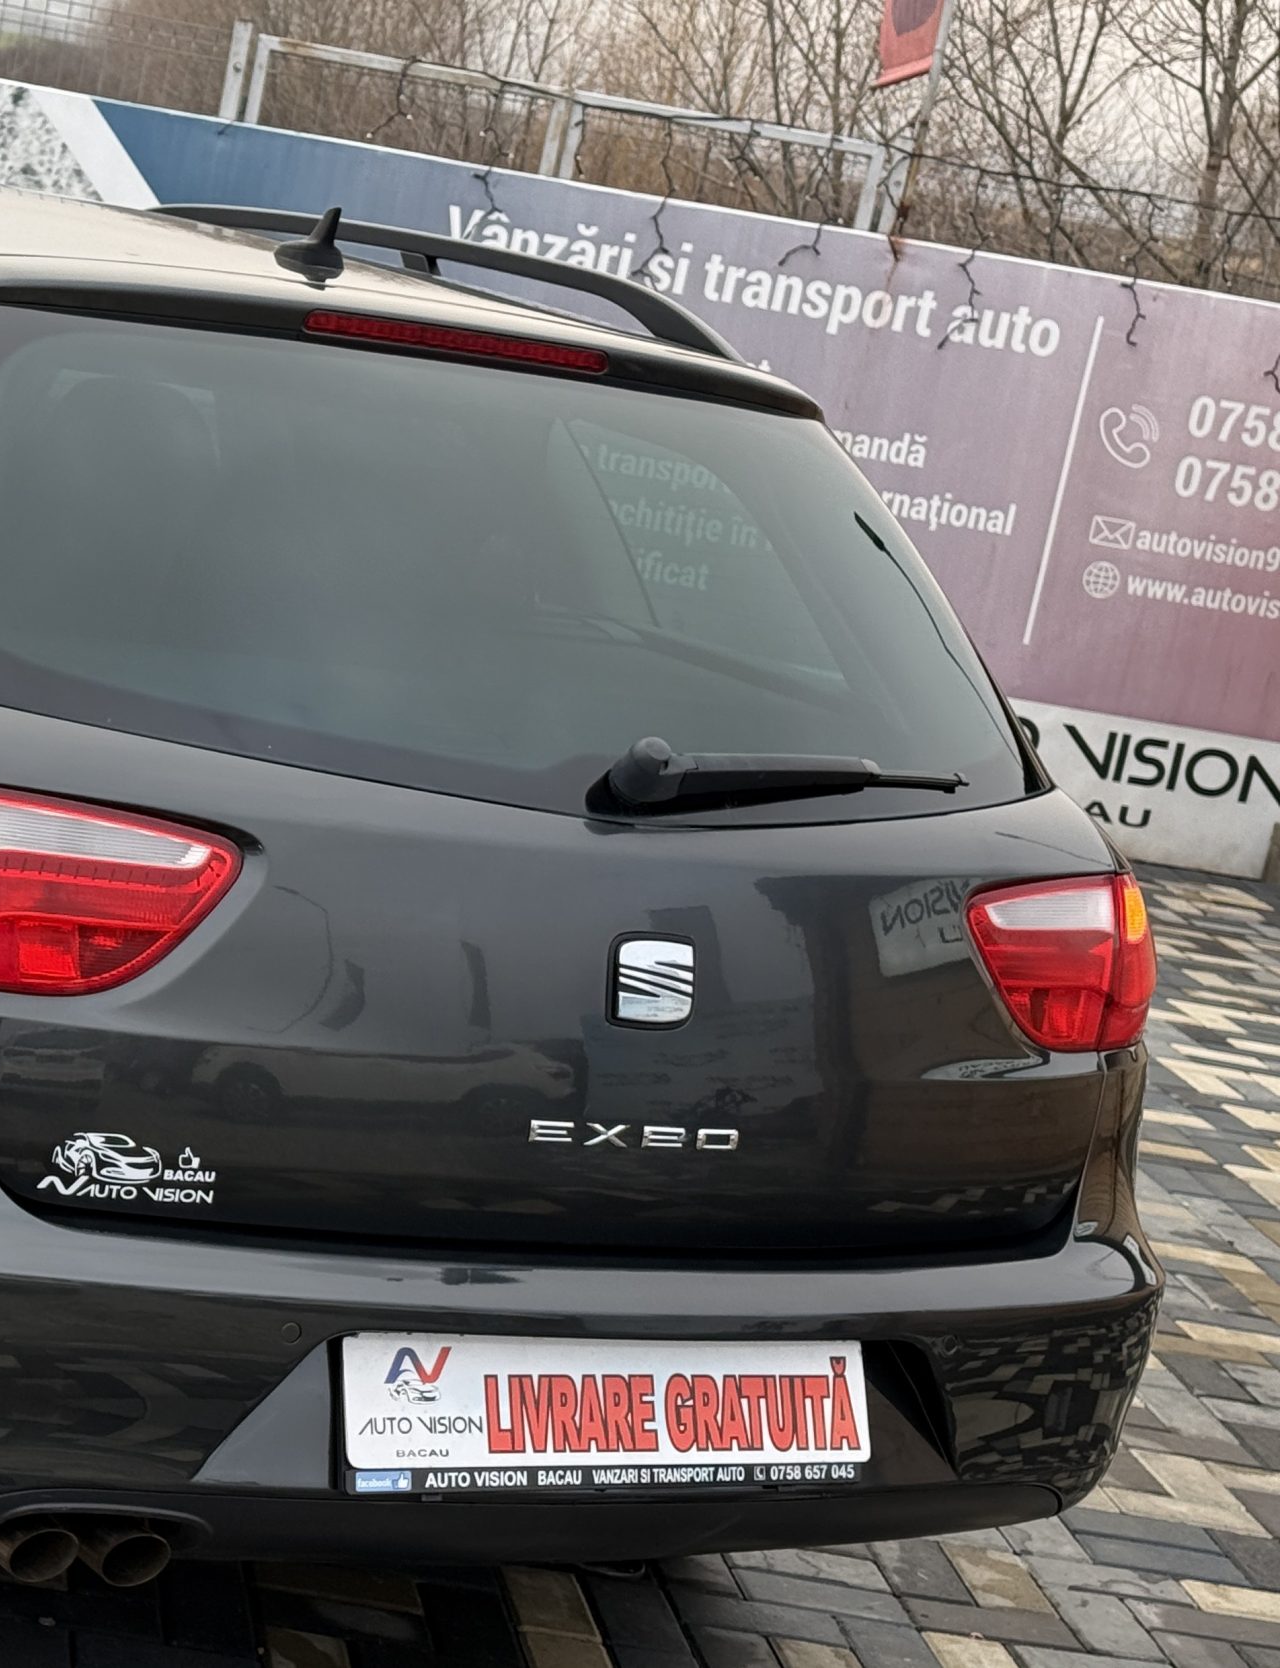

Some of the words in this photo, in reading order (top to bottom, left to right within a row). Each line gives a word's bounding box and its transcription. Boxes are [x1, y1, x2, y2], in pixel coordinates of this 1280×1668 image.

[703, 253, 937, 337] transport
[946, 304, 1061, 358] auto
[1174, 455, 1279, 511] 0758
[1063, 722, 1280, 807] VISION
[163, 1168, 216, 1182] BACAU
[77, 1184, 137, 1200] AUTO
[143, 1186, 214, 1204] VISION
[484, 1374, 659, 1453] LIVRARE
[664, 1356, 861, 1452] GRATUITĂ
[359, 1417, 412, 1435] AUTO
[417, 1416, 483, 1435] VISION
[396, 1449, 449, 1458] BACAU
[425, 1472, 470, 1488] AUTO
[474, 1471, 528, 1487] VISION
[537, 1470, 582, 1486] BACAU
[592, 1468, 637, 1484] VANZARI
[640, 1468, 651, 1483] SI
[652, 1467, 716, 1483] TRANSPORT
[716, 1467, 745, 1482] AUTO
[770, 1465, 801, 1481] 0758
[804, 1465, 827, 1480] 657
[831, 1464, 855, 1479] 045
